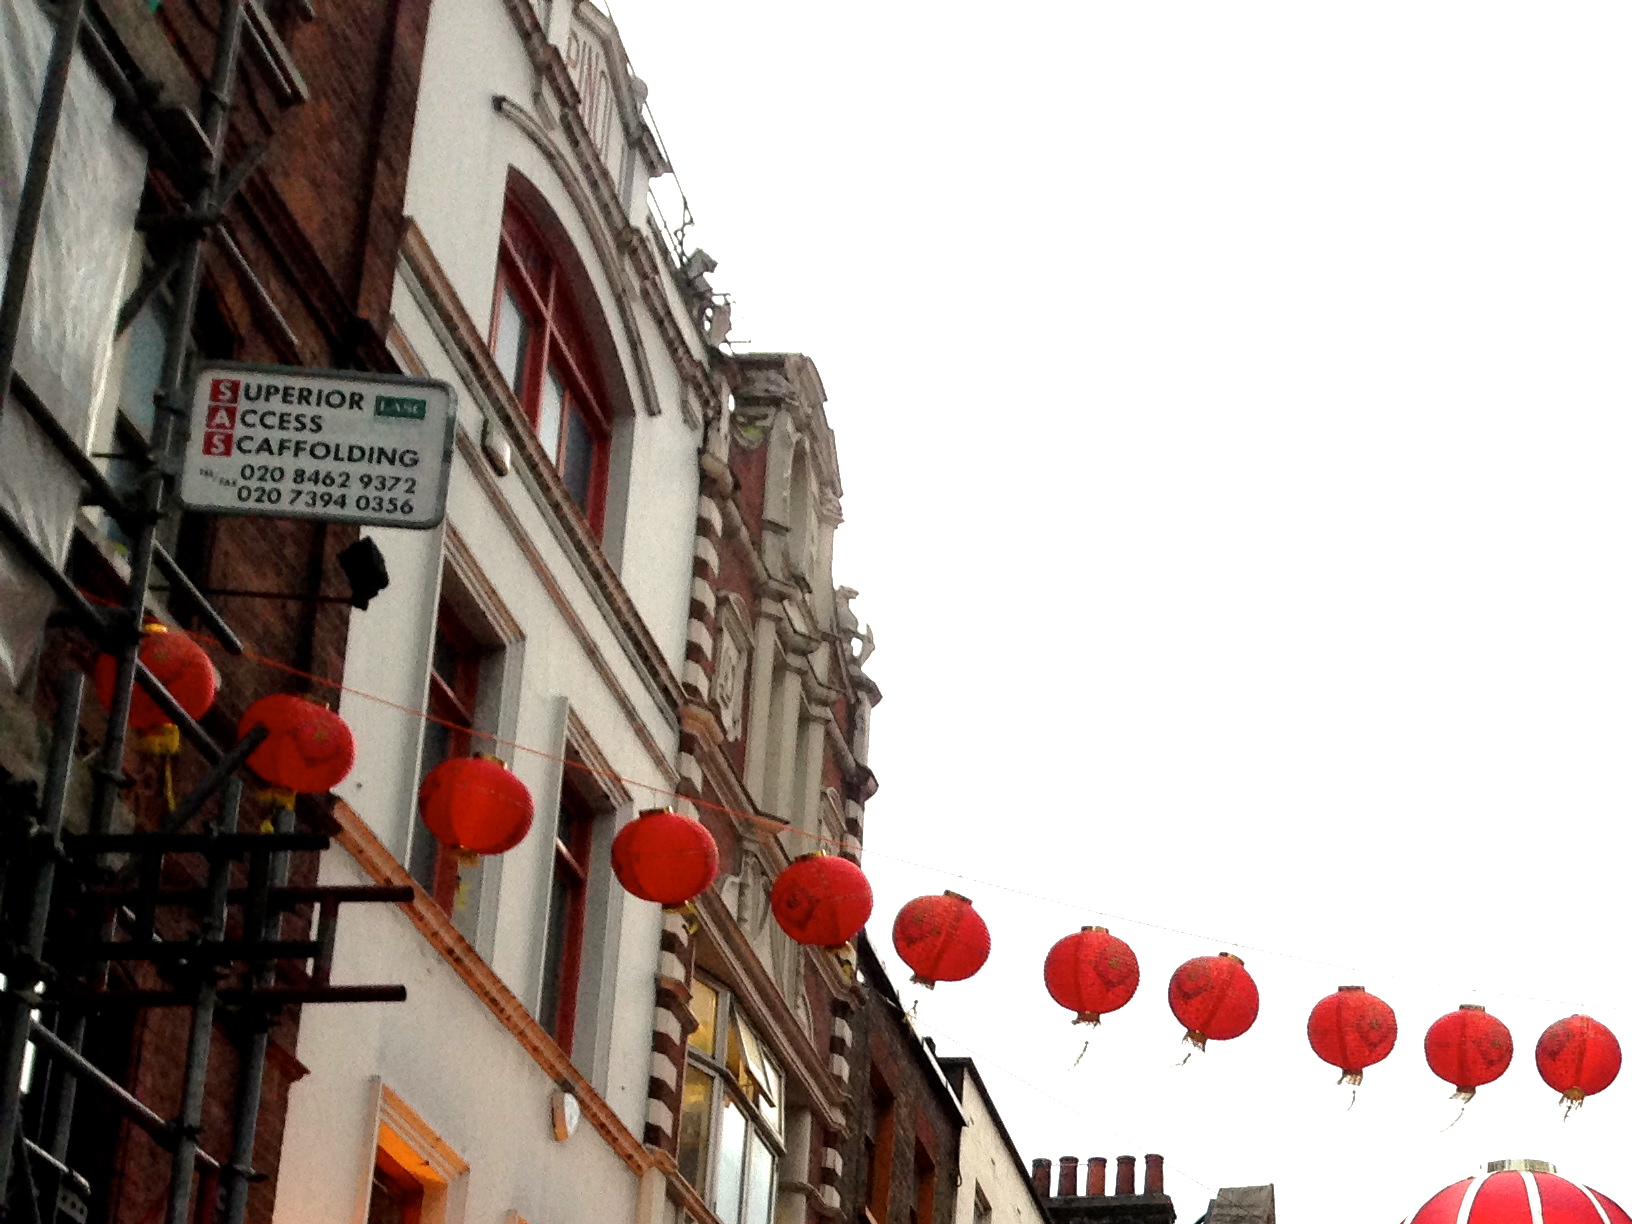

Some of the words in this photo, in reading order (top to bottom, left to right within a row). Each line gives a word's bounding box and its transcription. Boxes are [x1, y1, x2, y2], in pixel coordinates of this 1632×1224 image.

[211, 379, 365, 411] SUPERIOR
[206, 405, 323, 434] ACCESS
[203, 431, 420, 468] SCAFFOLDING
[240, 464, 286, 481] 020
[292, 468, 351, 488] 8462
[358, 473, 417, 494] 9372
[236, 485, 282, 504] 020
[288, 489, 347, 509] 7394
[355, 495, 414, 515] 0356
